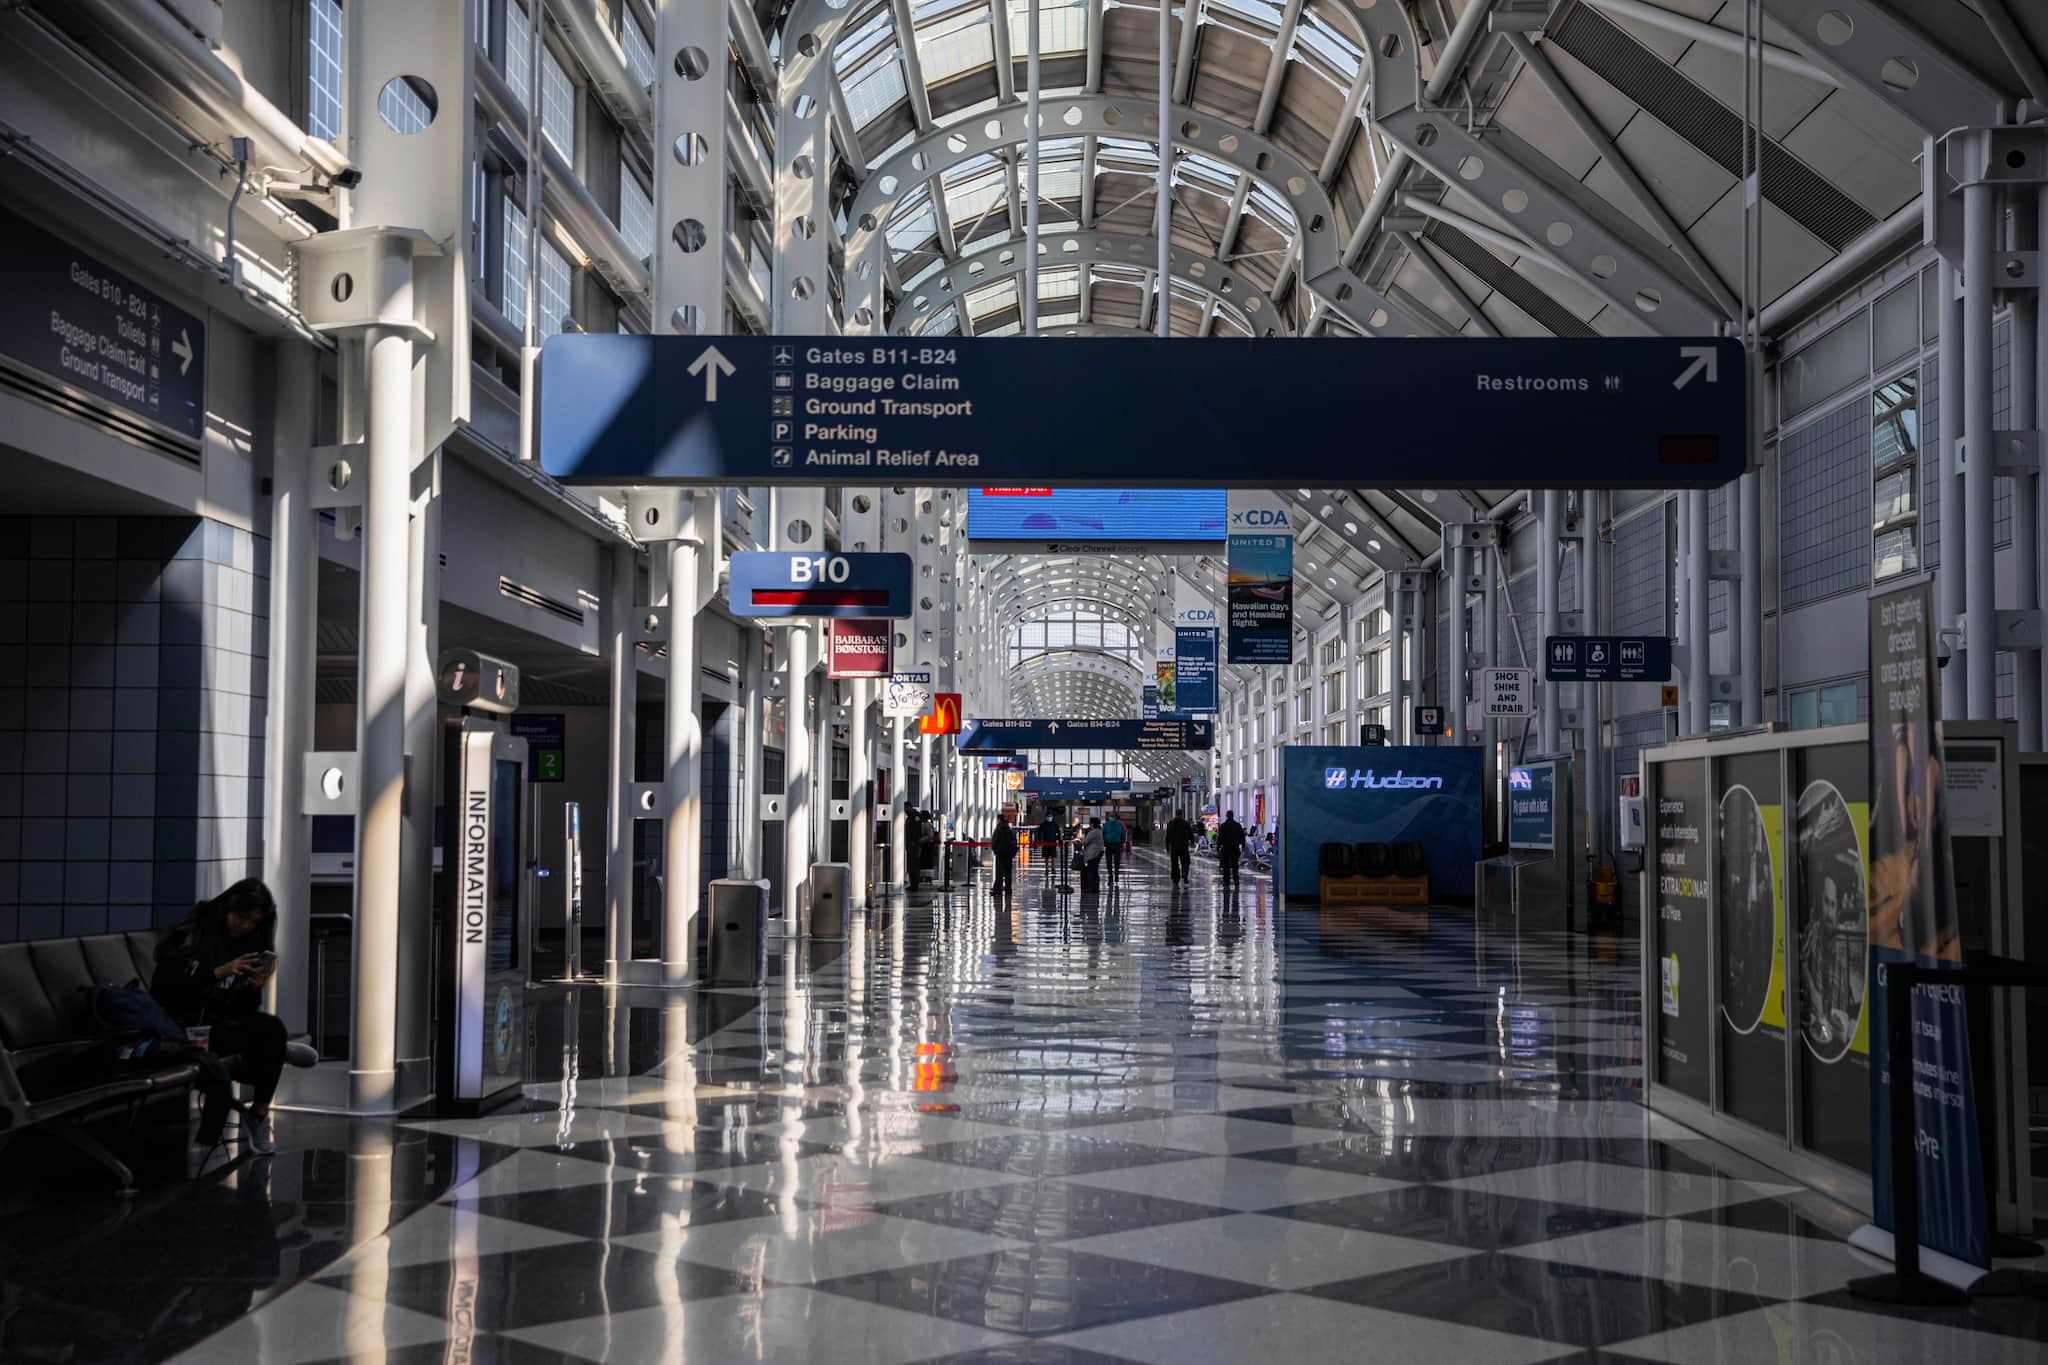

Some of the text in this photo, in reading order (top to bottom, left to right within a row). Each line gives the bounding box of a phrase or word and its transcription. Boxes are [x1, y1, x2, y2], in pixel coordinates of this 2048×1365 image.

[70, 262, 100, 295] Gates
[102, 282, 121, 304] B10
[128, 293, 146, 320] B24
[116, 314, 146, 348] Toilets
[52, 311, 146, 375] Baggage Claim/Exit
[806, 348, 957, 364] Gates B11-B24
[61, 347, 145, 403] Ground Transport
[806, 374, 959, 392] Baggage Claim
[1477, 375, 1589, 390] Restrooms
[806, 400, 972, 418] Ground Transport
[804, 425, 877, 443] Parking
[806, 450, 978, 466] Animal Relief Area
[1246, 510, 1288, 525] CDA
[790, 556, 850, 583] B10
[1188, 610, 1215, 620] CDA
[1232, 602, 1288, 612] Hawaiian days
[1232, 619, 1259, 628] flights.
[835, 636, 887, 644] BARBARA'S
[835, 645, 887, 654] BOOKSTORE
[1495, 672, 1519, 680] SHOE
[1498, 694, 1517, 702] AND
[1491, 704, 1523, 713] REPAIR
[546, 754, 555, 767] 2
[1351, 769, 1442, 789] Hudson
[466, 790, 486, 944] INFORMATION
